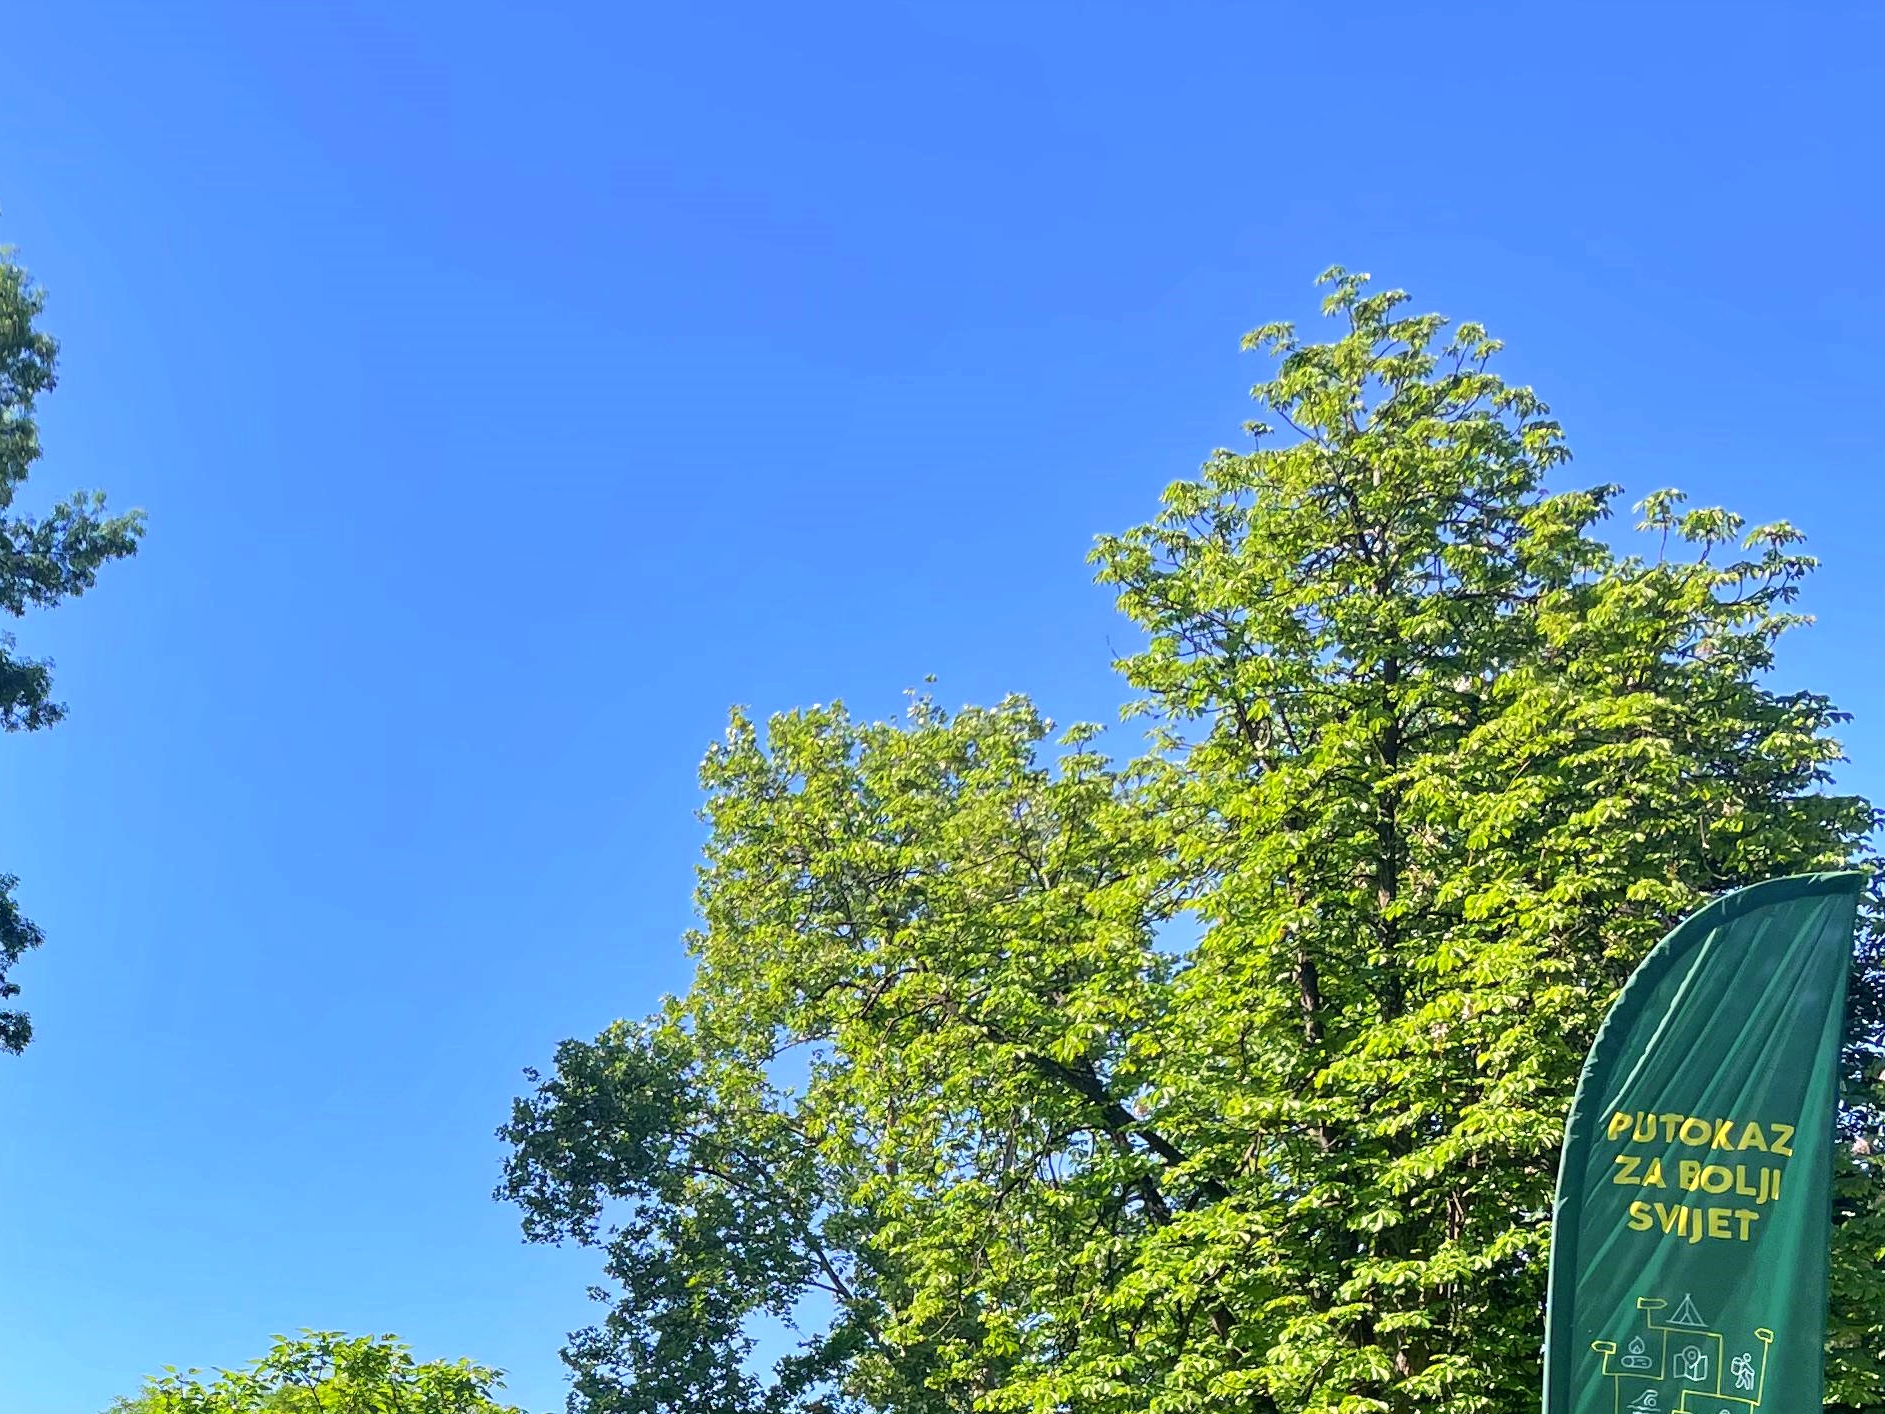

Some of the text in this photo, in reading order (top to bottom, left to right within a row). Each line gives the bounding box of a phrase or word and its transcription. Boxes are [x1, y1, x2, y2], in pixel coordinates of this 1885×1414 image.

[1606, 1111, 1796, 1157] PUTOKAZ
[1613, 1154, 1781, 1204] ZA BOLJI
[1627, 1201, 1760, 1244] SVIJET
